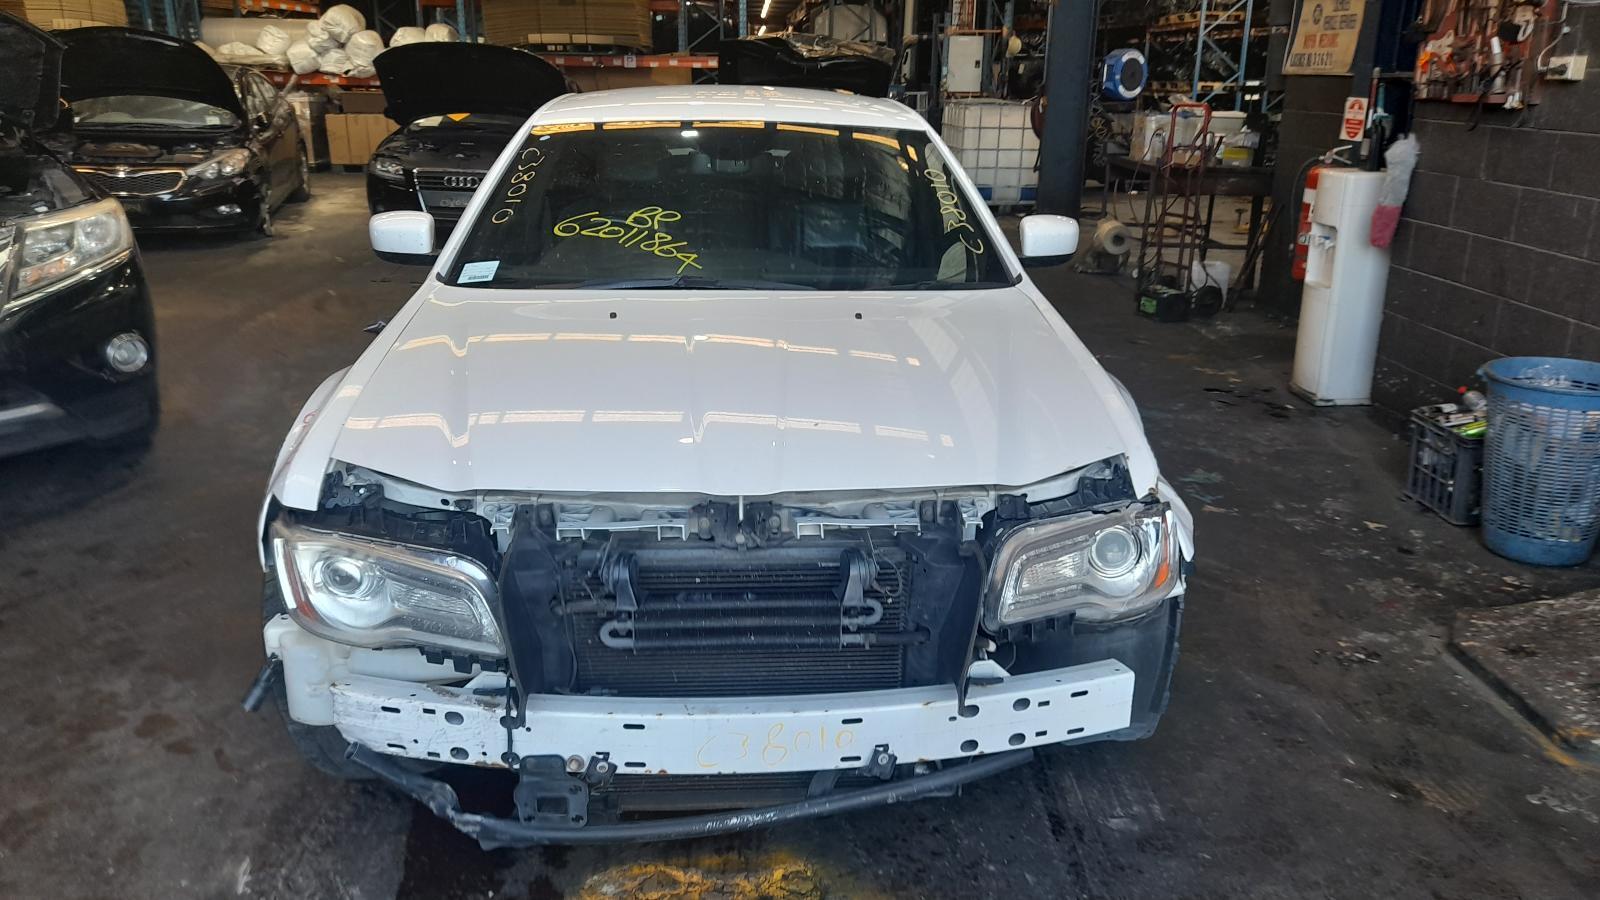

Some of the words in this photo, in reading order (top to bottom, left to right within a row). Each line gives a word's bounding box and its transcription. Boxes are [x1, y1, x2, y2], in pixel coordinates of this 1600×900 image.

[491, 147, 546, 224] C38010
[923, 168, 984, 254] C38010
[696, 722, 854, 768] C38010
